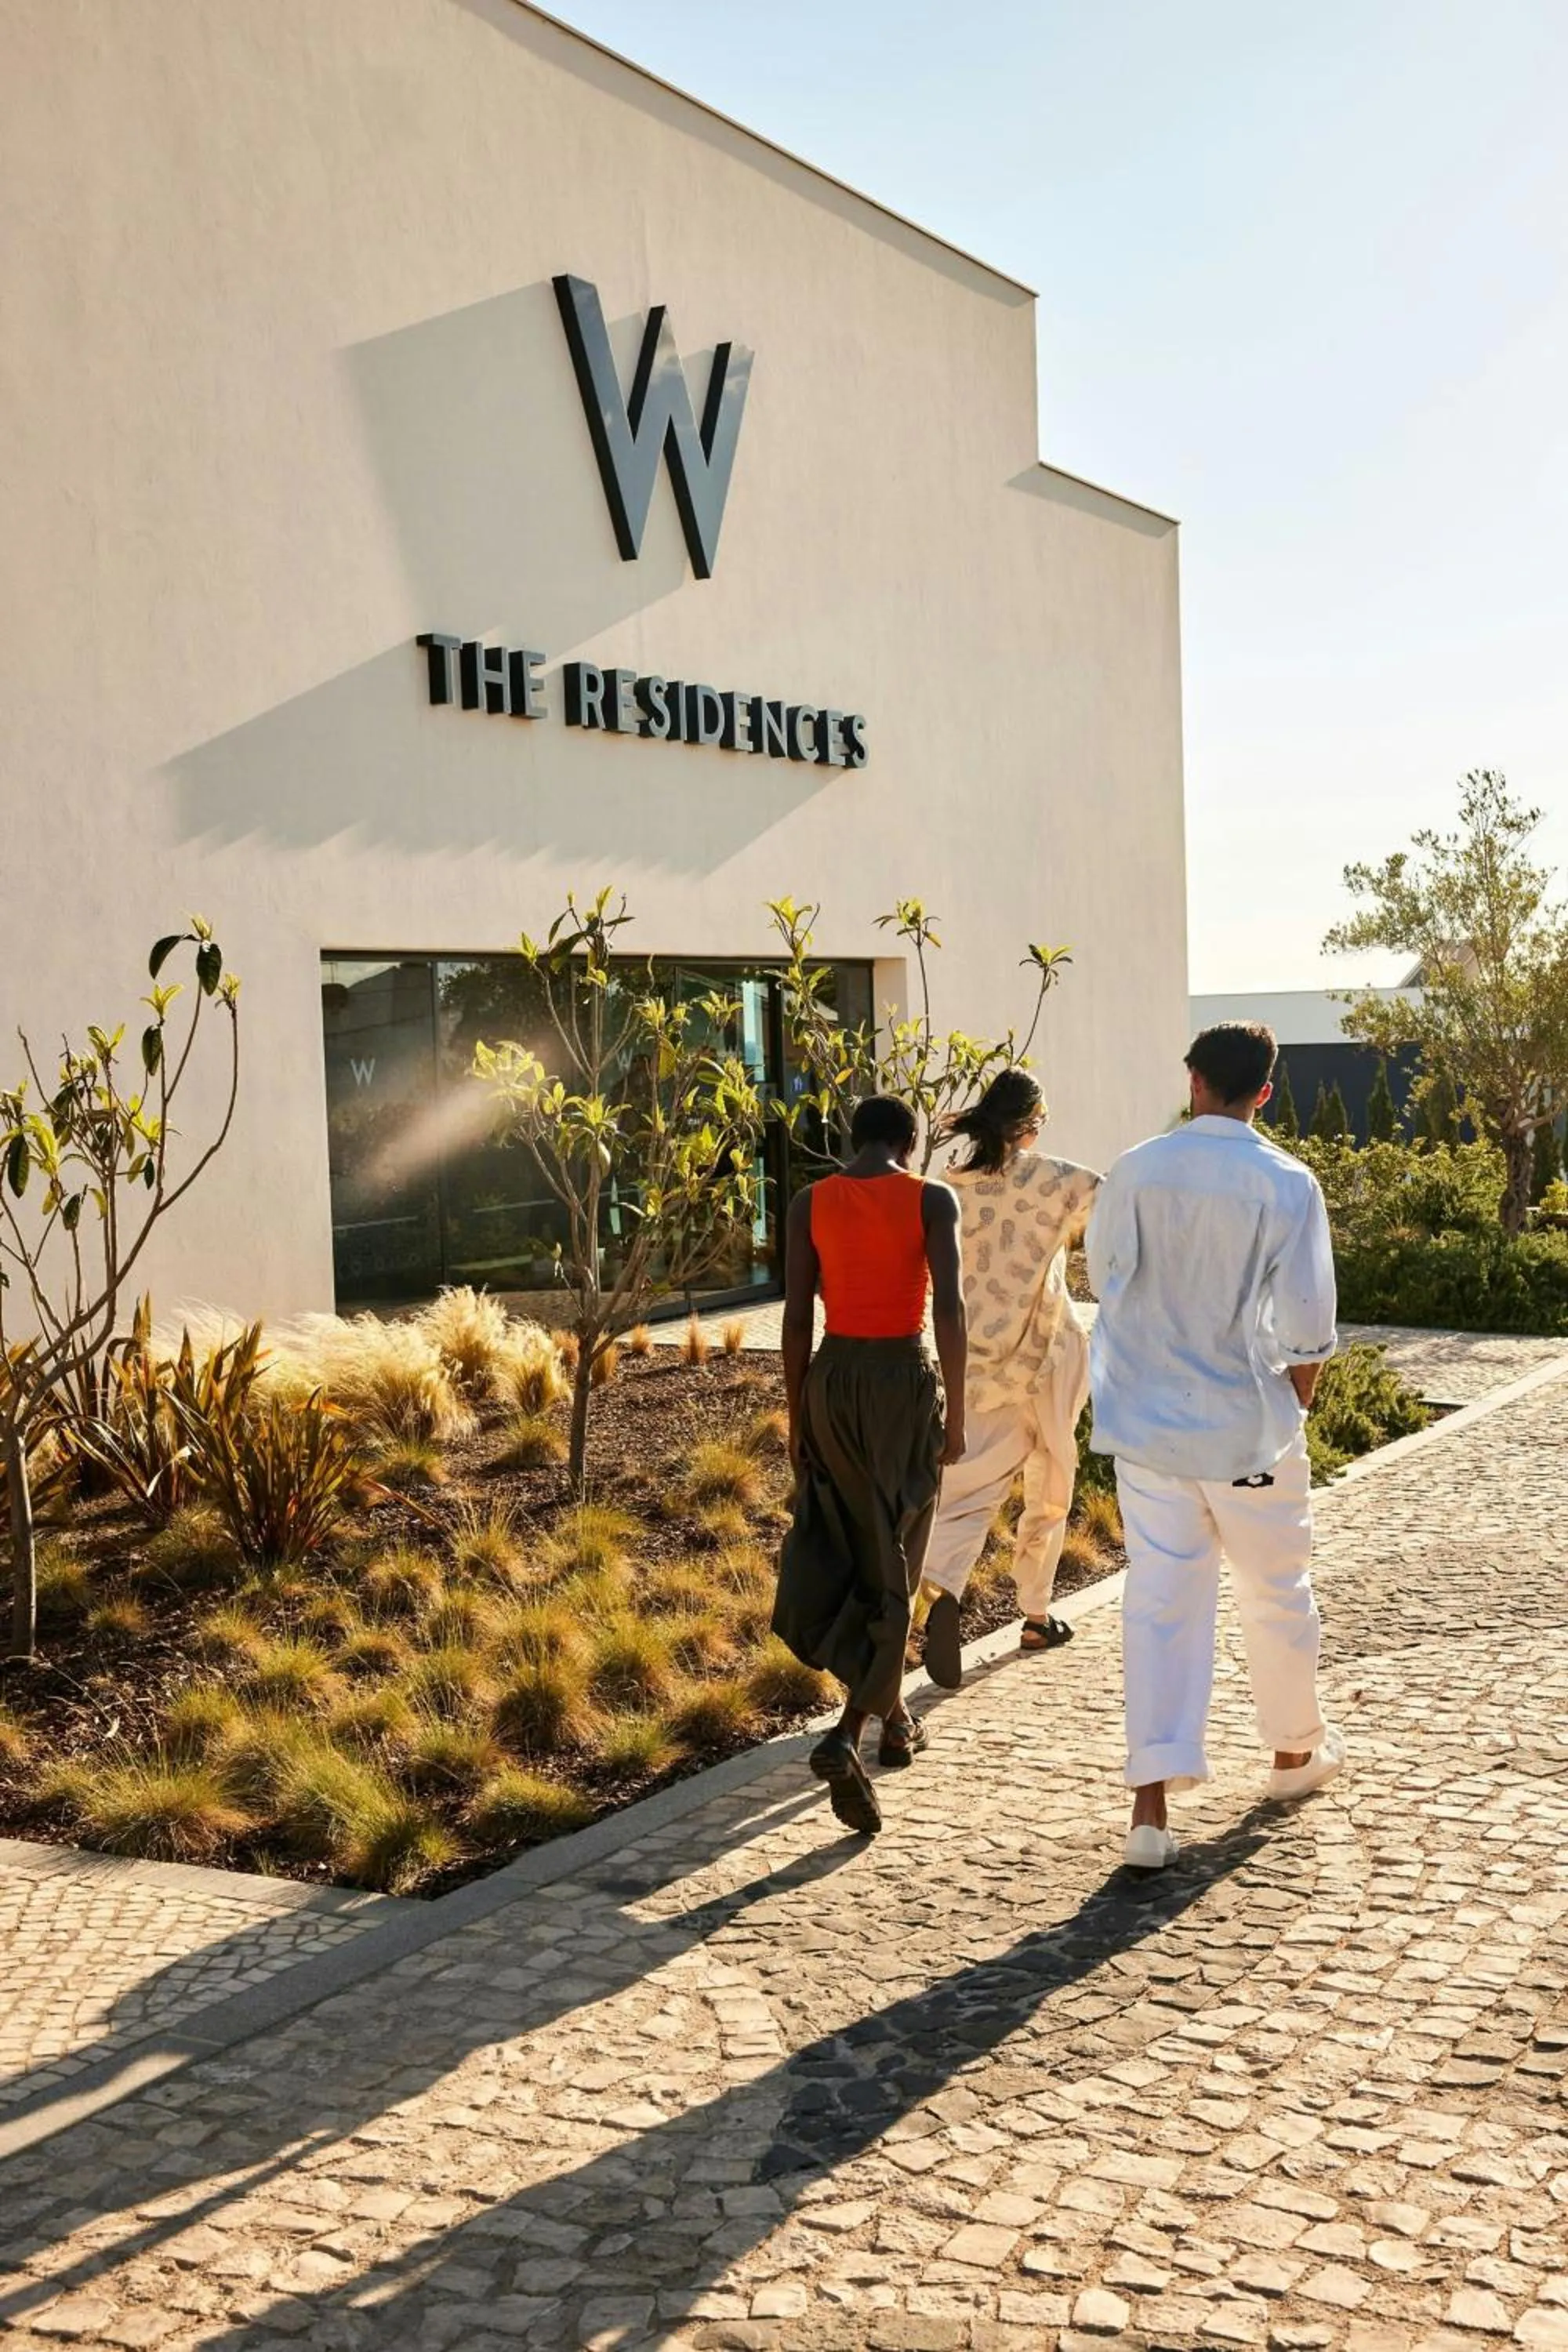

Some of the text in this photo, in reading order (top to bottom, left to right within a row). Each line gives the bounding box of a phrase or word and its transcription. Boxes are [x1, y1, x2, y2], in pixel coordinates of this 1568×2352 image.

[552, 274, 755, 580] W
[416, 633, 869, 768] THE RESIDENCES
[350, 1058, 376, 1086] W
